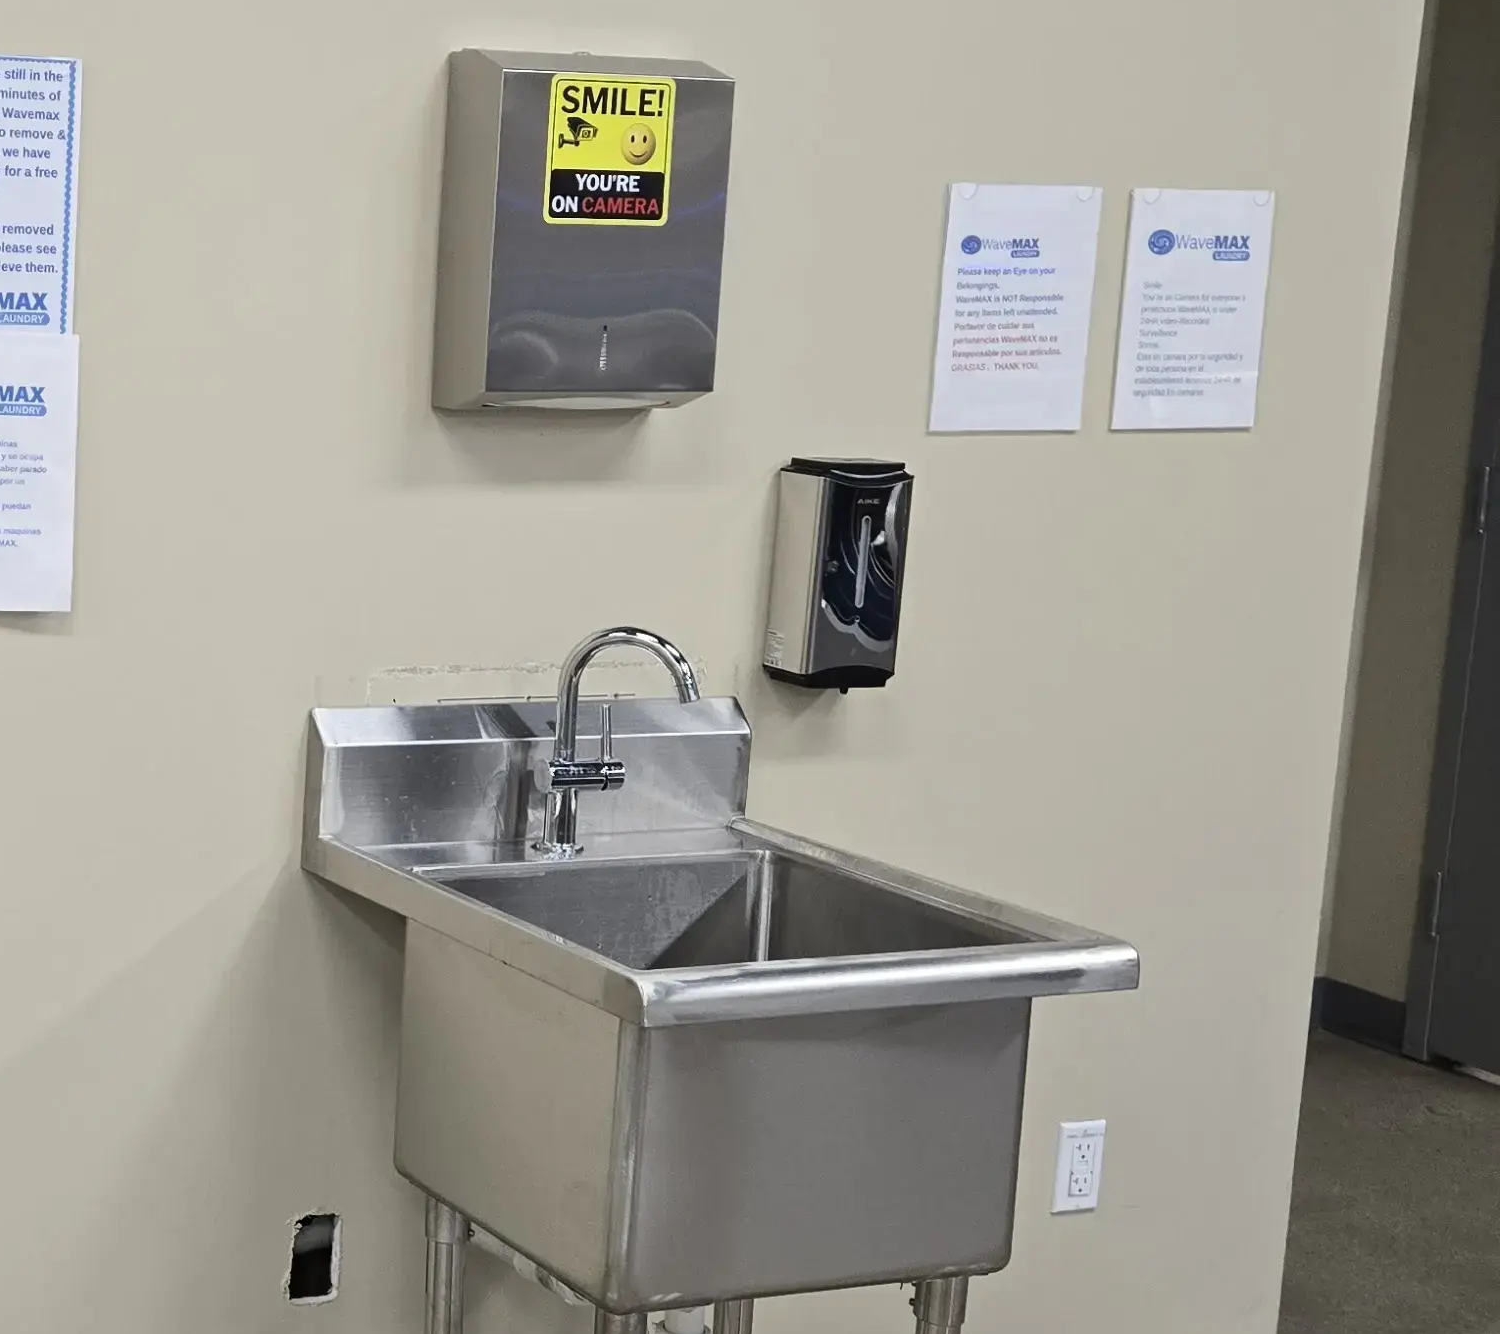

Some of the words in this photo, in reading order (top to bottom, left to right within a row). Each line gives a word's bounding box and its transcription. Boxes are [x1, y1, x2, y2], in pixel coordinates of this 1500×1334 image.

[4, 68, 26, 81] still
[29, 69, 41, 81] in
[44, 70, 64, 83] the
[49, 90, 61, 101] of
[561, 85, 665, 117] SMILE!
[2, 107, 60, 121] Wavemax
[9, 129, 53, 140] remove
[57, 129, 66, 140] &
[2, 148, 19, 158] we
[22, 147, 51, 159] have
[4, 165, 22, 177] for
[24, 169, 31, 177] a
[35, 166, 58, 178] free
[576, 174, 640, 192] YOU'RE
[552, 195, 578, 213] ON
[582, 198, 659, 214] CAMERA
[2, 223, 54, 236] removed
[982, 238, 1040, 250] WaveMAX
[1175, 234, 1250, 250] WaveMAX
[36, 244, 57, 254] see
[25, 262, 59, 273] them.
[1014, 268, 1026, 276] Eye
[1039, 268, 1056, 276] your
[1002, 295, 1018, 303] NOT
